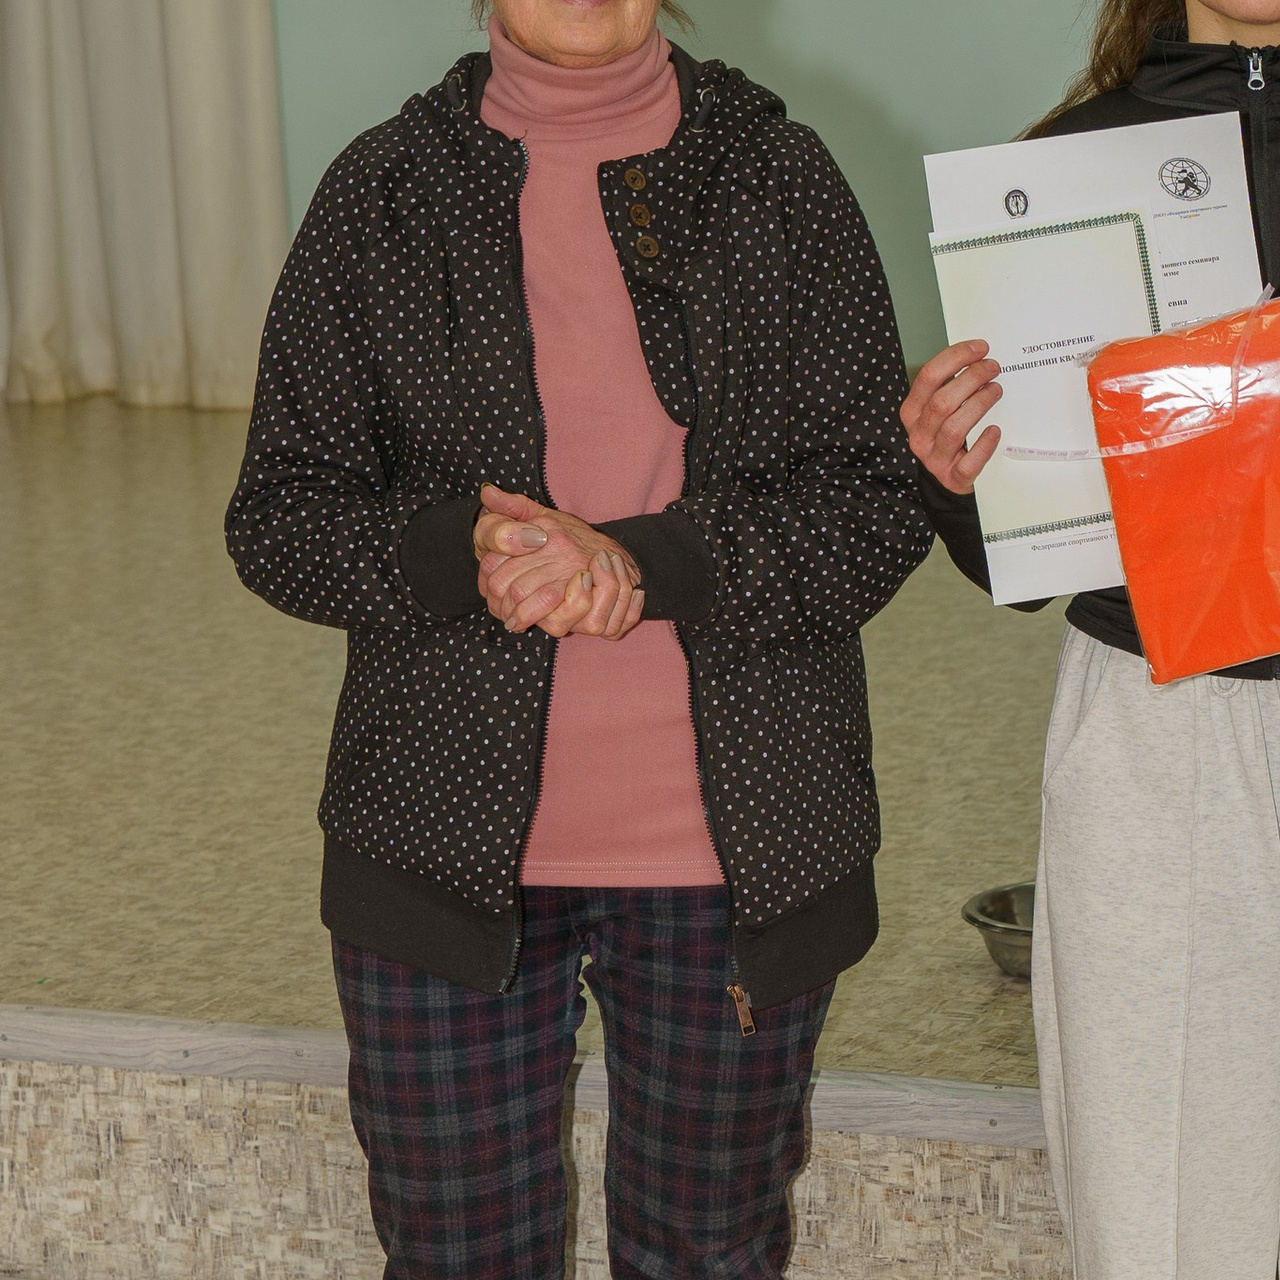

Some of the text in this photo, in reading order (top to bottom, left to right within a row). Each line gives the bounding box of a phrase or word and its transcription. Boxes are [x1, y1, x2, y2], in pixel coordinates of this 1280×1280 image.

[1188, 256, 1220, 265] семинара
[1162, 270, 1180, 278] изме
[1168, 299, 1188, 308] евна
[1022, 335, 1095, 354] УДОСТОВЕРЕНИЕ
[999, 358, 1058, 374] ПОВЫШЕНИИ
